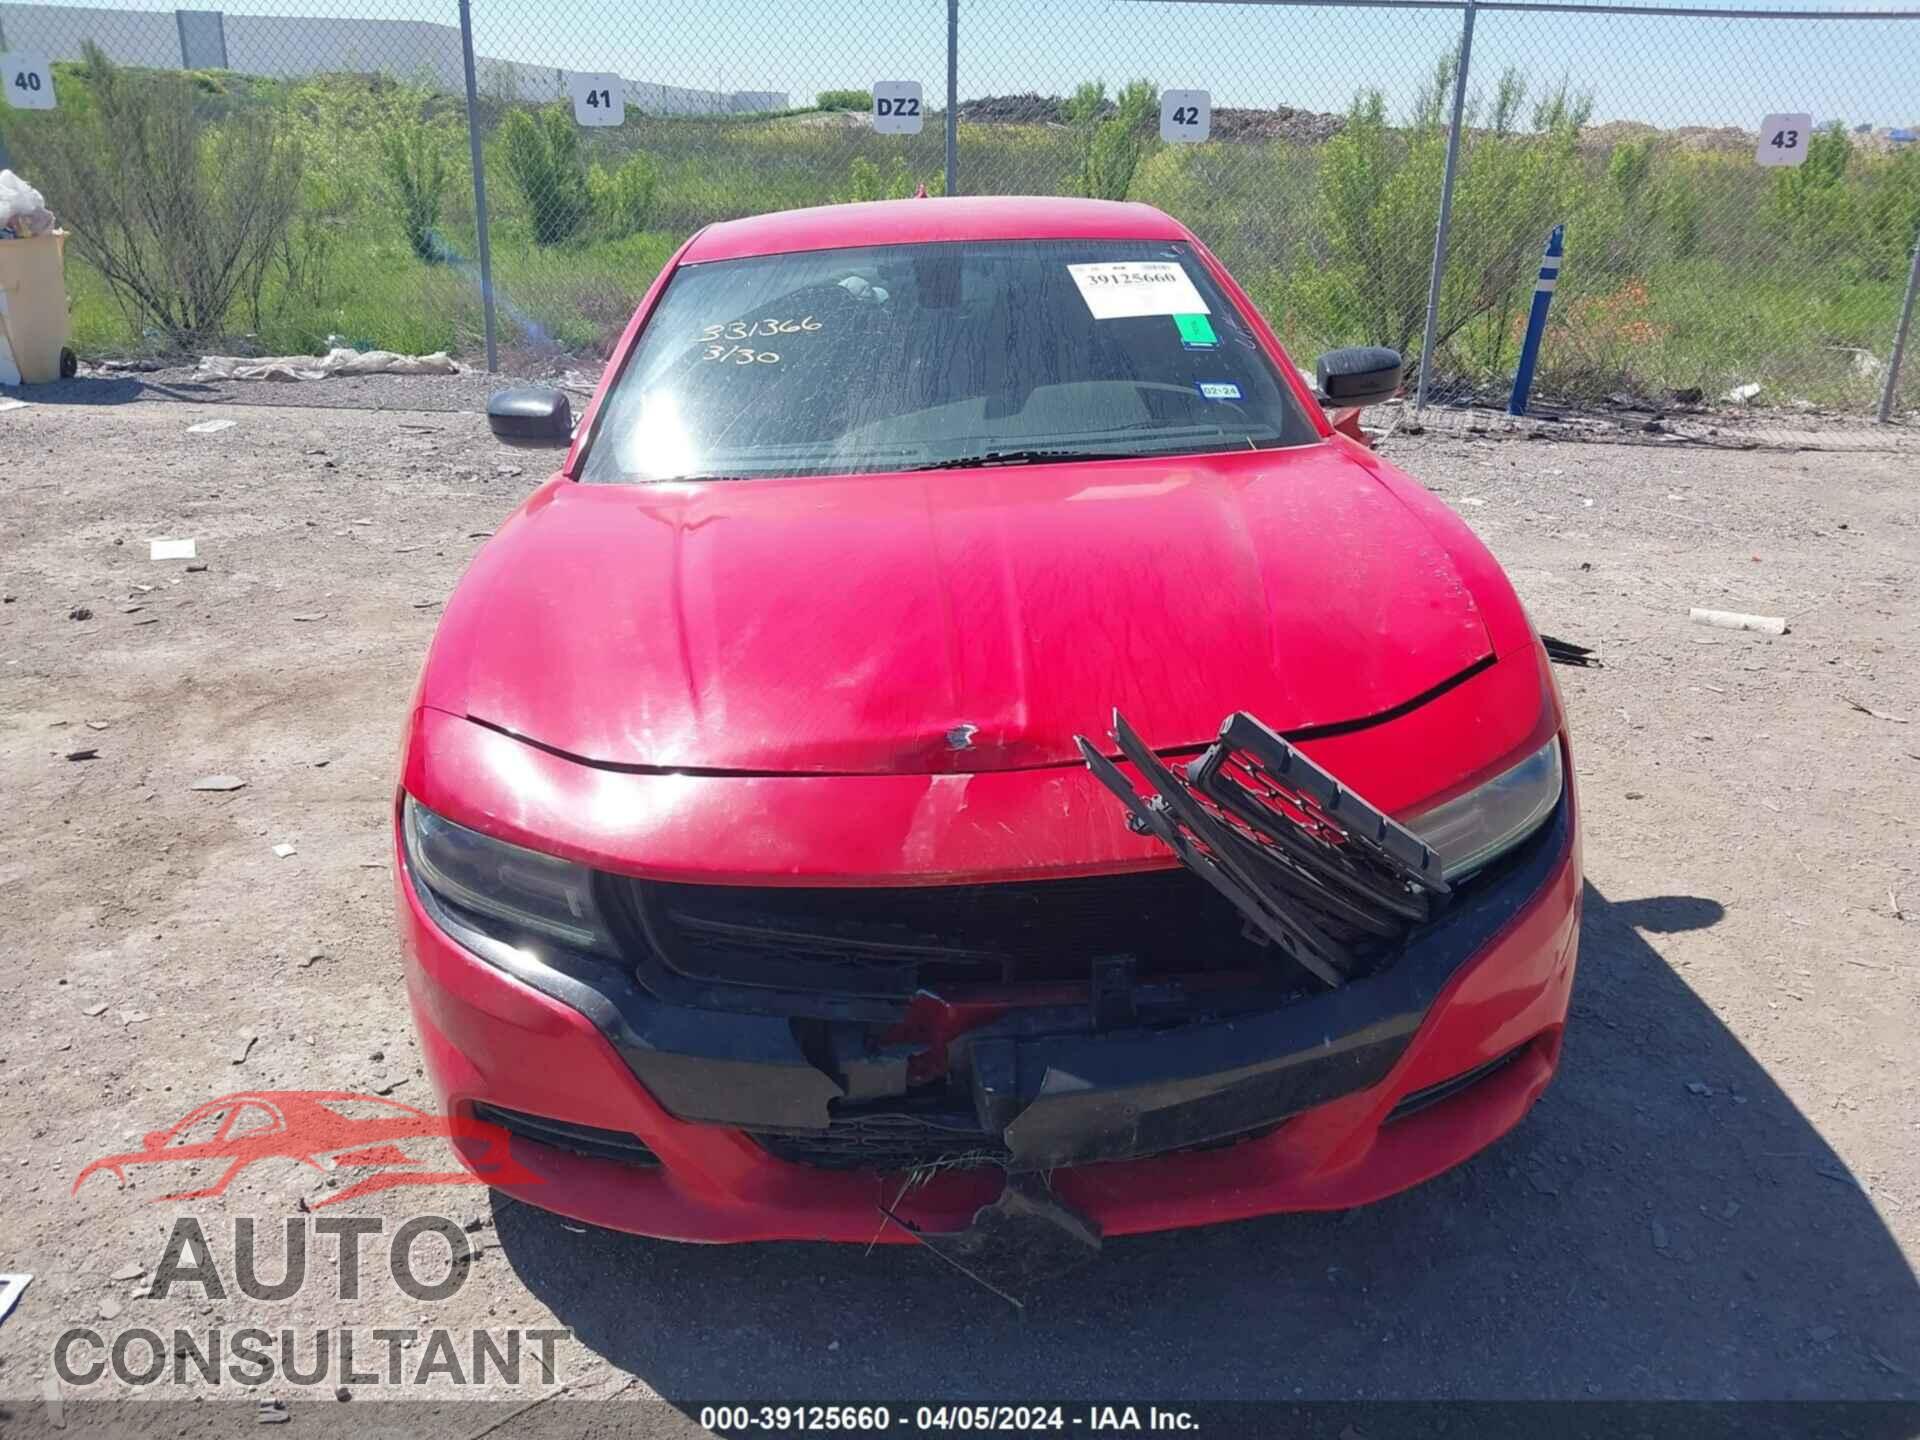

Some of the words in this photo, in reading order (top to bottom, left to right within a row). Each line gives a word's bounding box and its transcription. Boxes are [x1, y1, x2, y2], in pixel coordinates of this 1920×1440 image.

[15, 71, 41, 91] 40
[586, 89, 611, 108] 41
[877, 97, 920, 117] DZ2
[1172, 106, 1198, 125] 42
[1771, 130, 1798, 149] 43
[1088, 272, 1177, 286] 39125660
[695, 315, 822, 342] 331366
[703, 345, 780, 365] 3/30
[1203, 386, 1238, 396] 02-24
